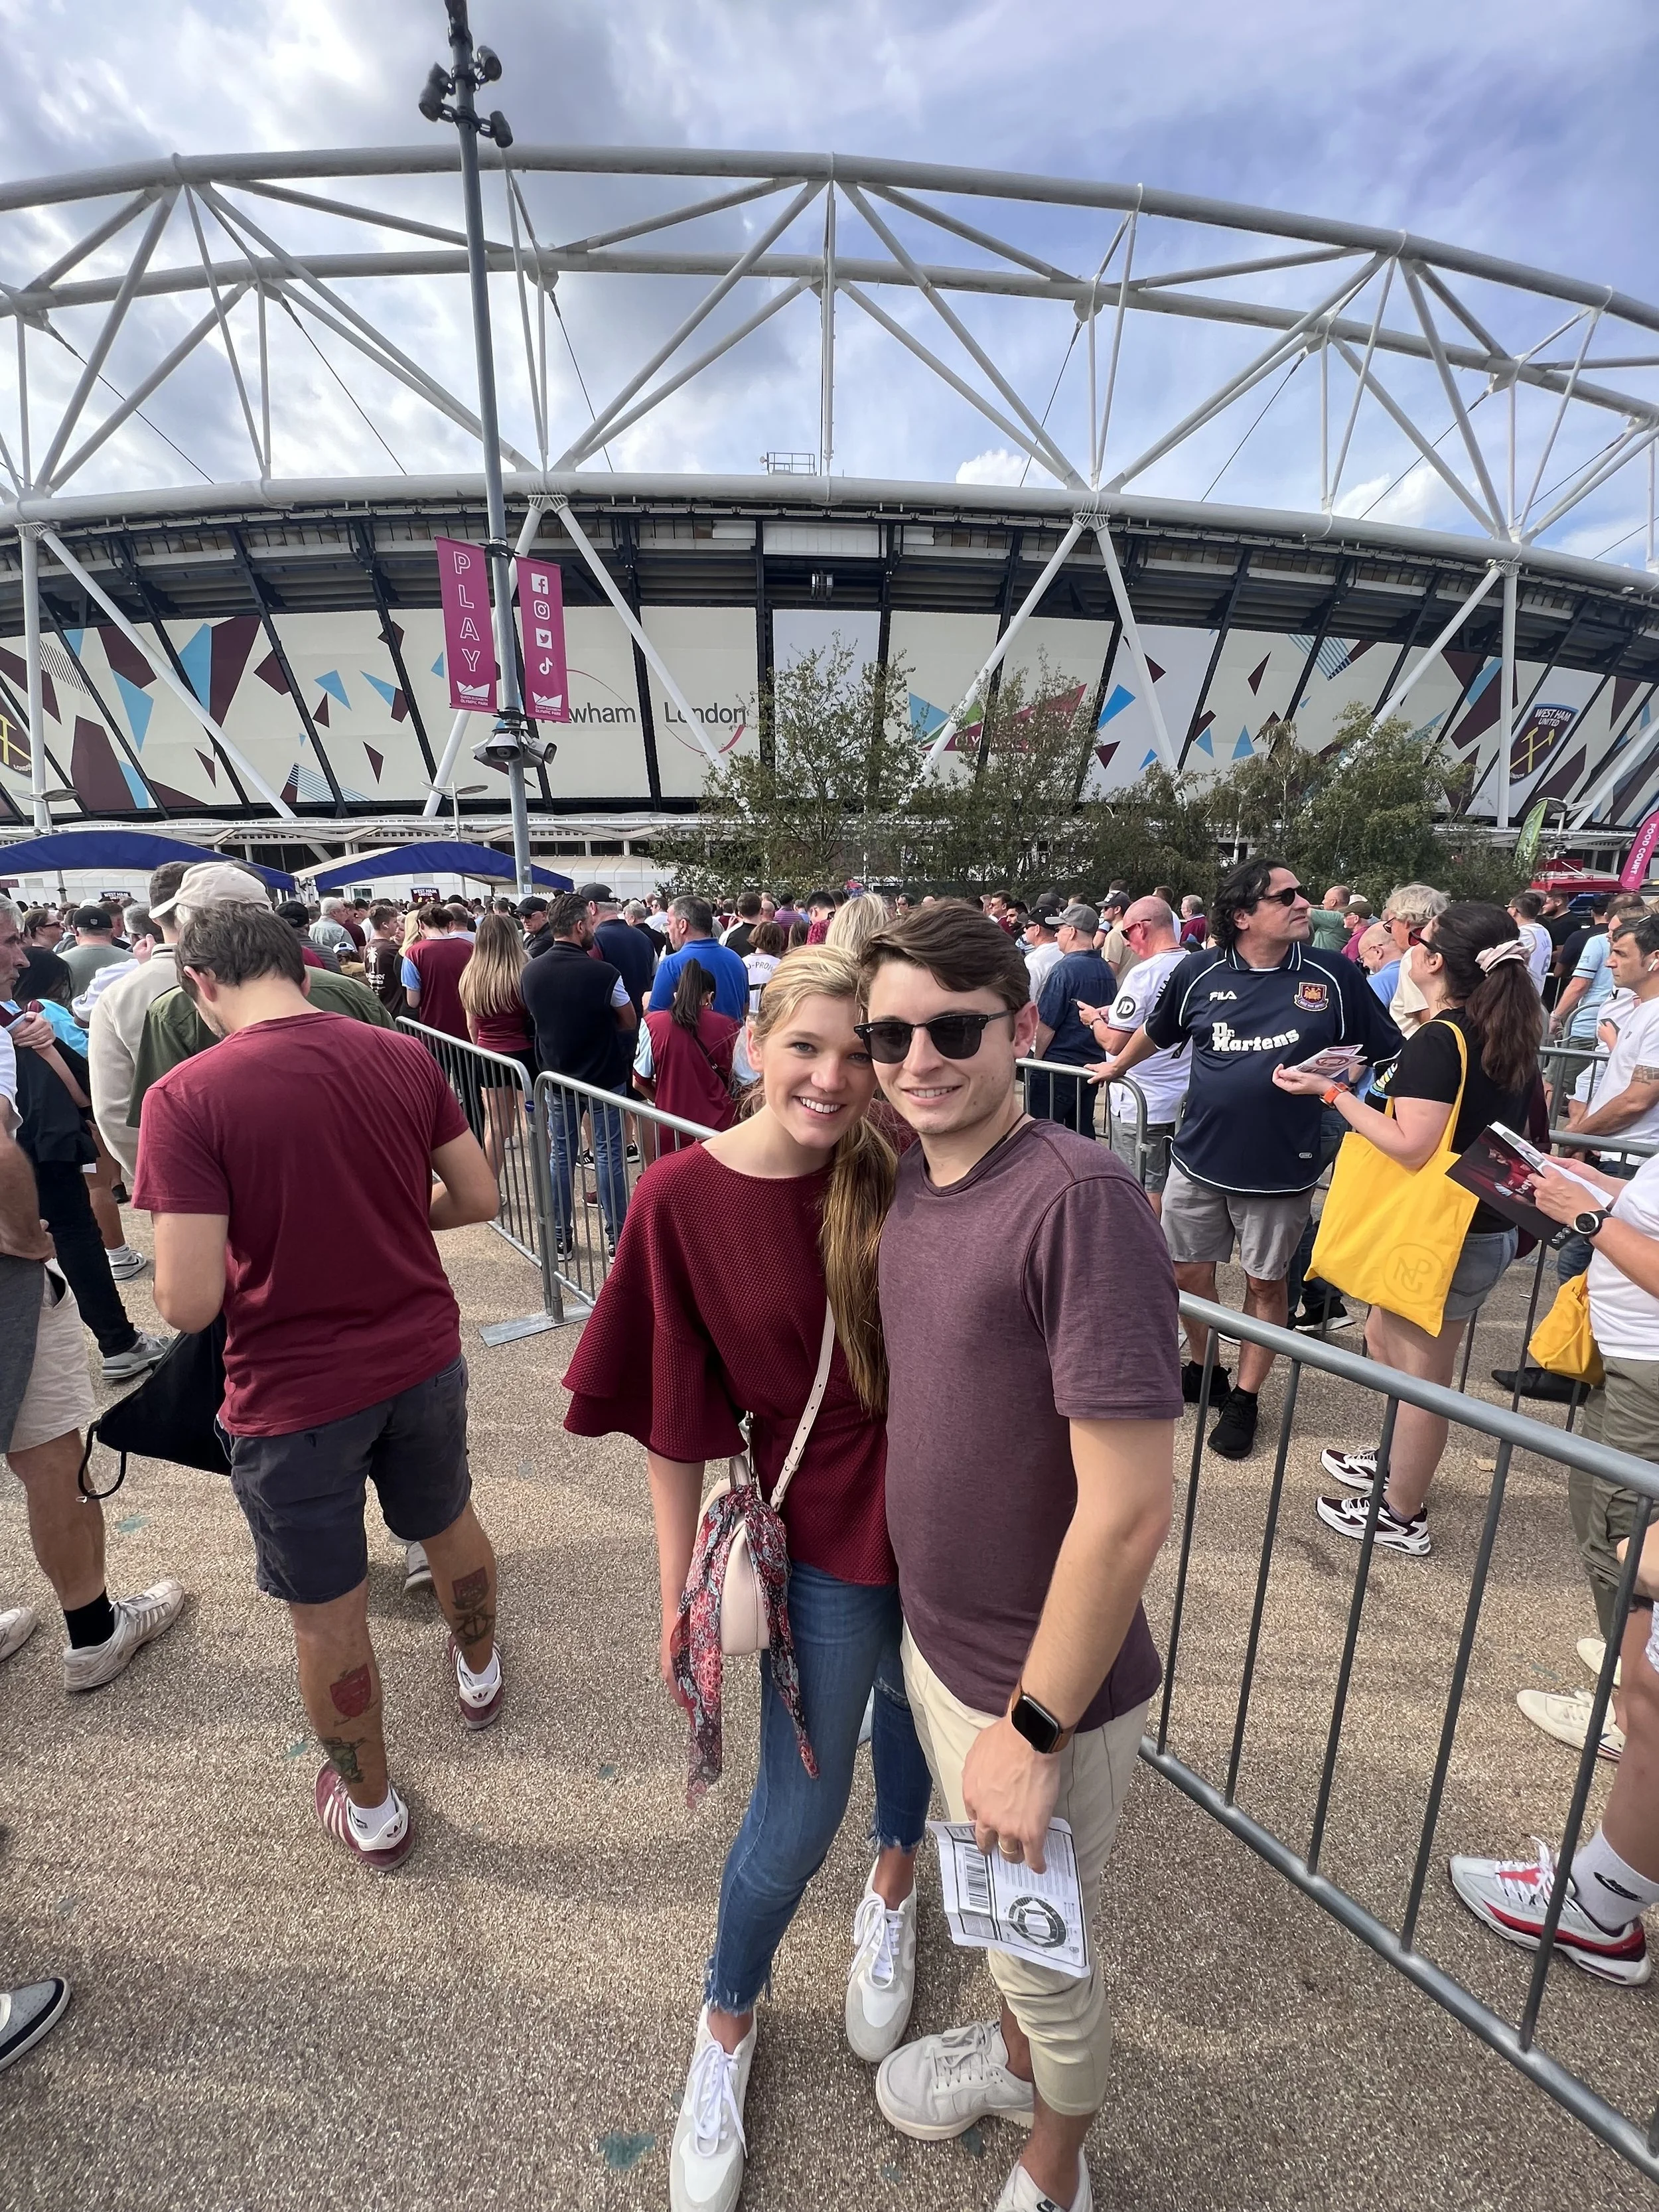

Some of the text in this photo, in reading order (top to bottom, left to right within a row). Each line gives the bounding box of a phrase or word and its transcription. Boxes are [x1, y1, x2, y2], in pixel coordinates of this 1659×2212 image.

[453, 551, 480, 672] PLAY
[541, 701, 636, 724] wham
[1535, 709, 1571, 722] WEST HAM
[1538, 719, 1560, 727] UNITED
[1630, 823, 1656, 875] FOOD COURT
[1209, 990, 1238, 1001] FILA
[1117, 1001, 1134, 1015] JD
[1212, 1029, 1300, 1052] Martens
